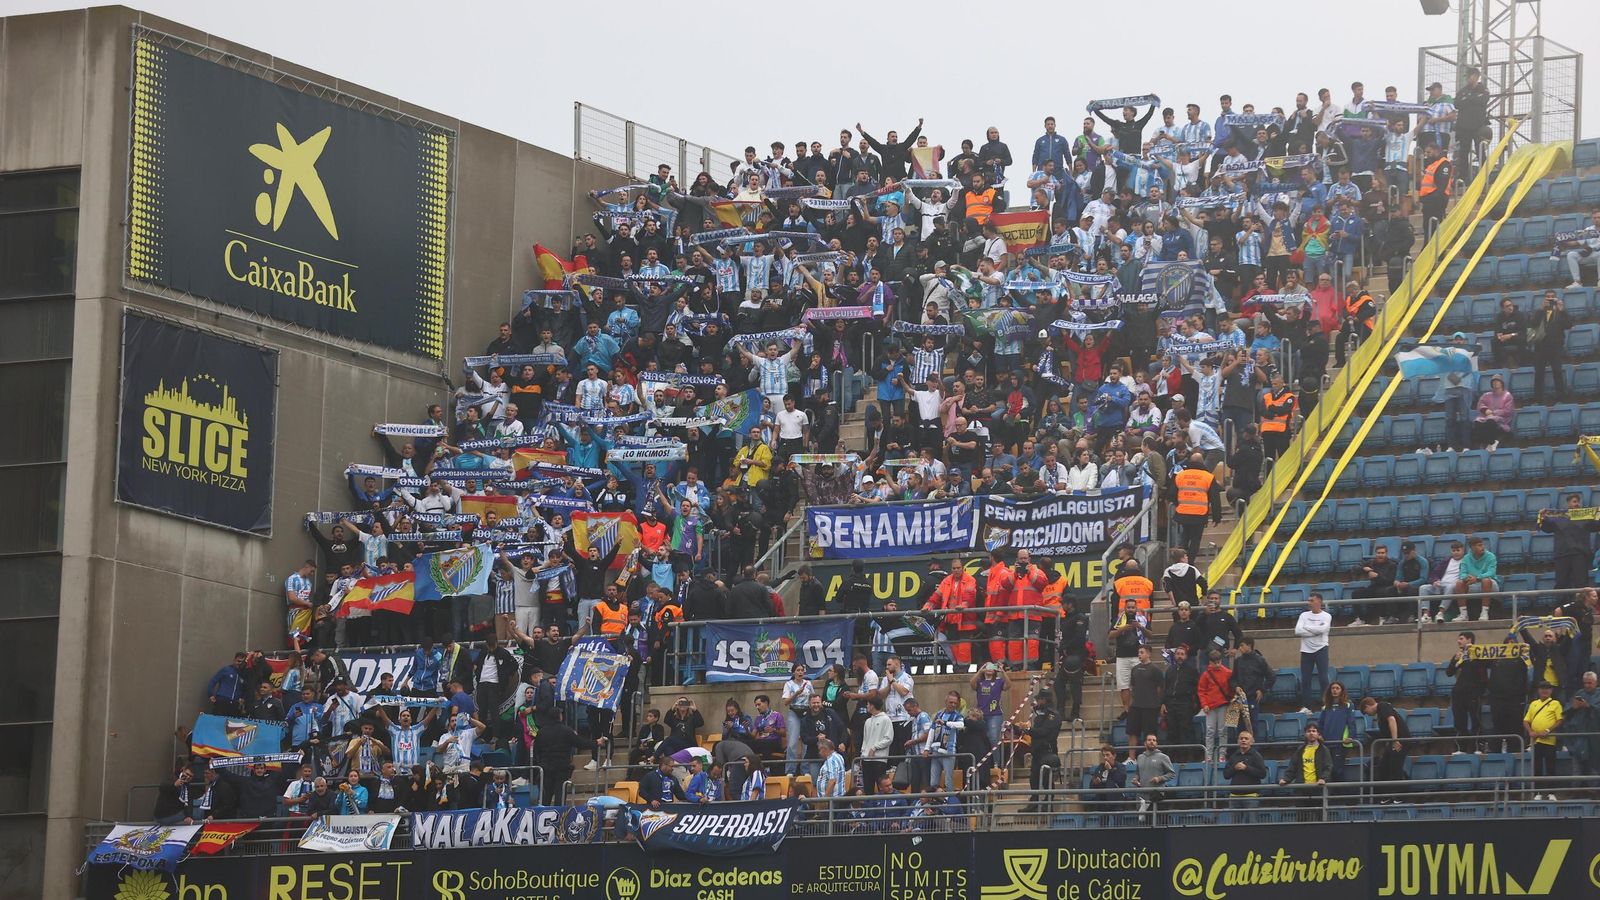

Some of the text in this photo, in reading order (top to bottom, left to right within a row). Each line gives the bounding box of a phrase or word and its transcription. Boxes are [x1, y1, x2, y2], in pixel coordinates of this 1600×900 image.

[224, 239, 357, 313] CaixaBank
[387, 426, 436, 434] INVENCIBLES
[143, 406, 249, 478] SLICE
[636, 449, 671, 458] HICIMOS!
[142, 456, 246, 492] NEW YORK PIZZA
[400, 478, 430, 487] ONDO
[984, 491, 1136, 522] PEÑA MALAGUISTA
[498, 518, 523, 527] ONDO
[814, 505, 968, 549] BENAMIEL
[1010, 520, 1105, 548] ARCHIDONA
[825, 571, 921, 602] AUD
[712, 638, 845, 670] 19 04
[1474, 645, 1507, 659] CADIZ
[331, 825, 368, 834] MALAGUISTA
[413, 807, 560, 850] MALAKAS
[94, 852, 167, 870] ESTEPONA
[891, 851, 922, 870] NO
[1057, 847, 1161, 873] Diputación
[1378, 842, 1500, 896] JOYMA
[269, 861, 413, 900] RESET
[469, 868, 600, 894] SohoBoutique
[650, 867, 783, 888] Díaz Cadenas
[819, 864, 881, 880] ESTUDIO
[890, 869, 967, 888] LIMITS
[1172, 847, 1364, 900] @Cadizturismo
[697, 889, 735, 900] CASH
[791, 881, 880, 894] DE ARQUITECTURA
[890, 889, 967, 900] SPACES
[1056, 878, 1141, 900] de Cádiz
